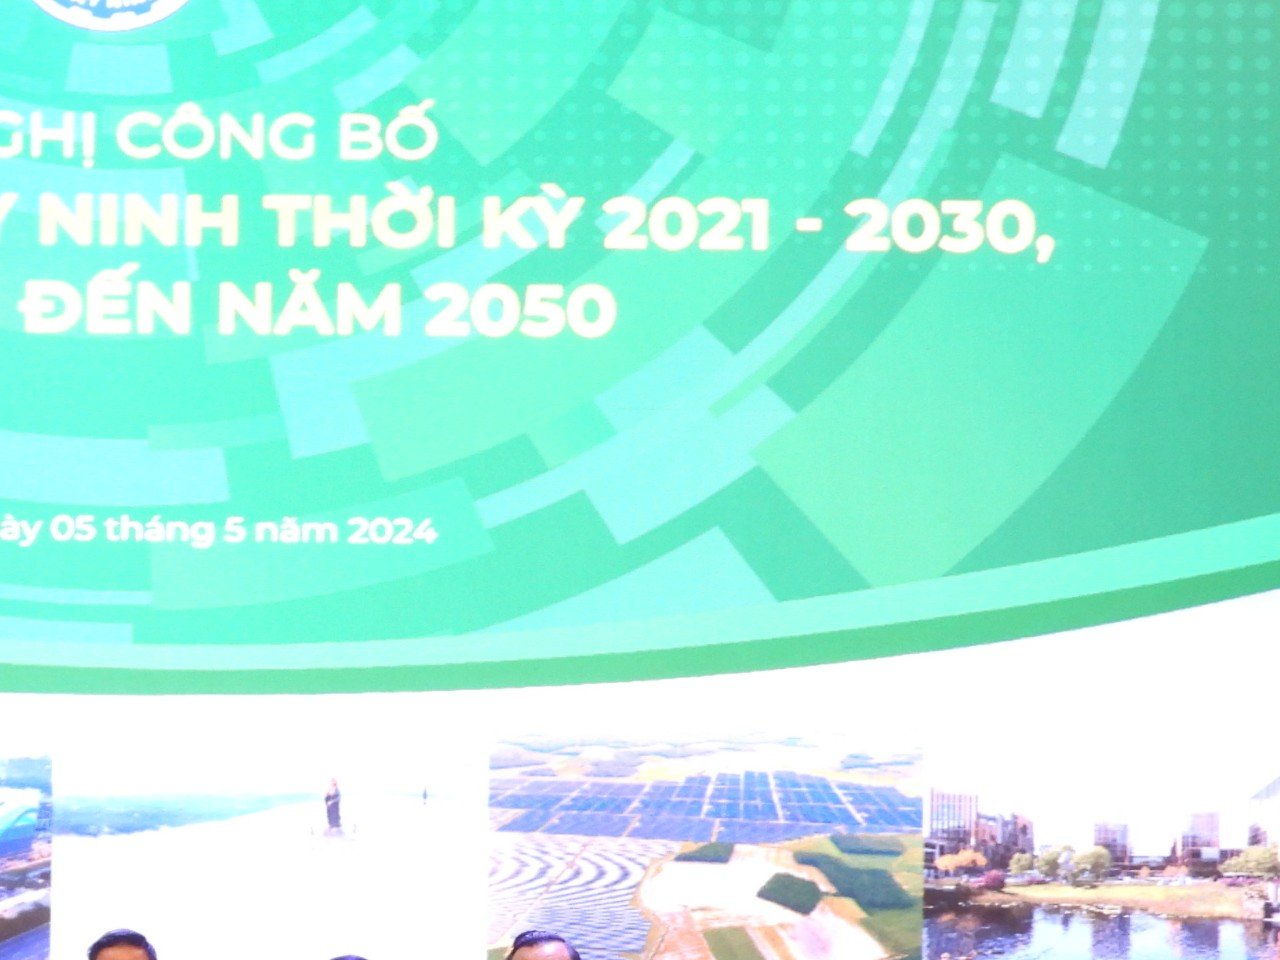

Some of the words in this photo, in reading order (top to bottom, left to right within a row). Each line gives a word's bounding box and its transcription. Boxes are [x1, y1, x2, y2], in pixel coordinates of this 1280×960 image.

[116, 102, 315, 160] CÔNG
[339, 99, 438, 160] BỐ
[39, 191, 238, 247] NINH
[263, 182, 456, 249] THỜI
[482, 184, 585, 249] KỲ
[603, 196, 770, 251] 2021
[796, 217, 822, 232] -
[844, 198, 1055, 264] 2030,
[18, 263, 191, 335] ĐẾN
[218, 269, 402, 337] NĂM
[424, 281, 617, 338] 2050
[50, 514, 97, 541] 05
[104, 514, 216, 549] tháng
[223, 516, 247, 543] 5
[255, 516, 338, 544] năm
[347, 516, 438, 544] 2024
